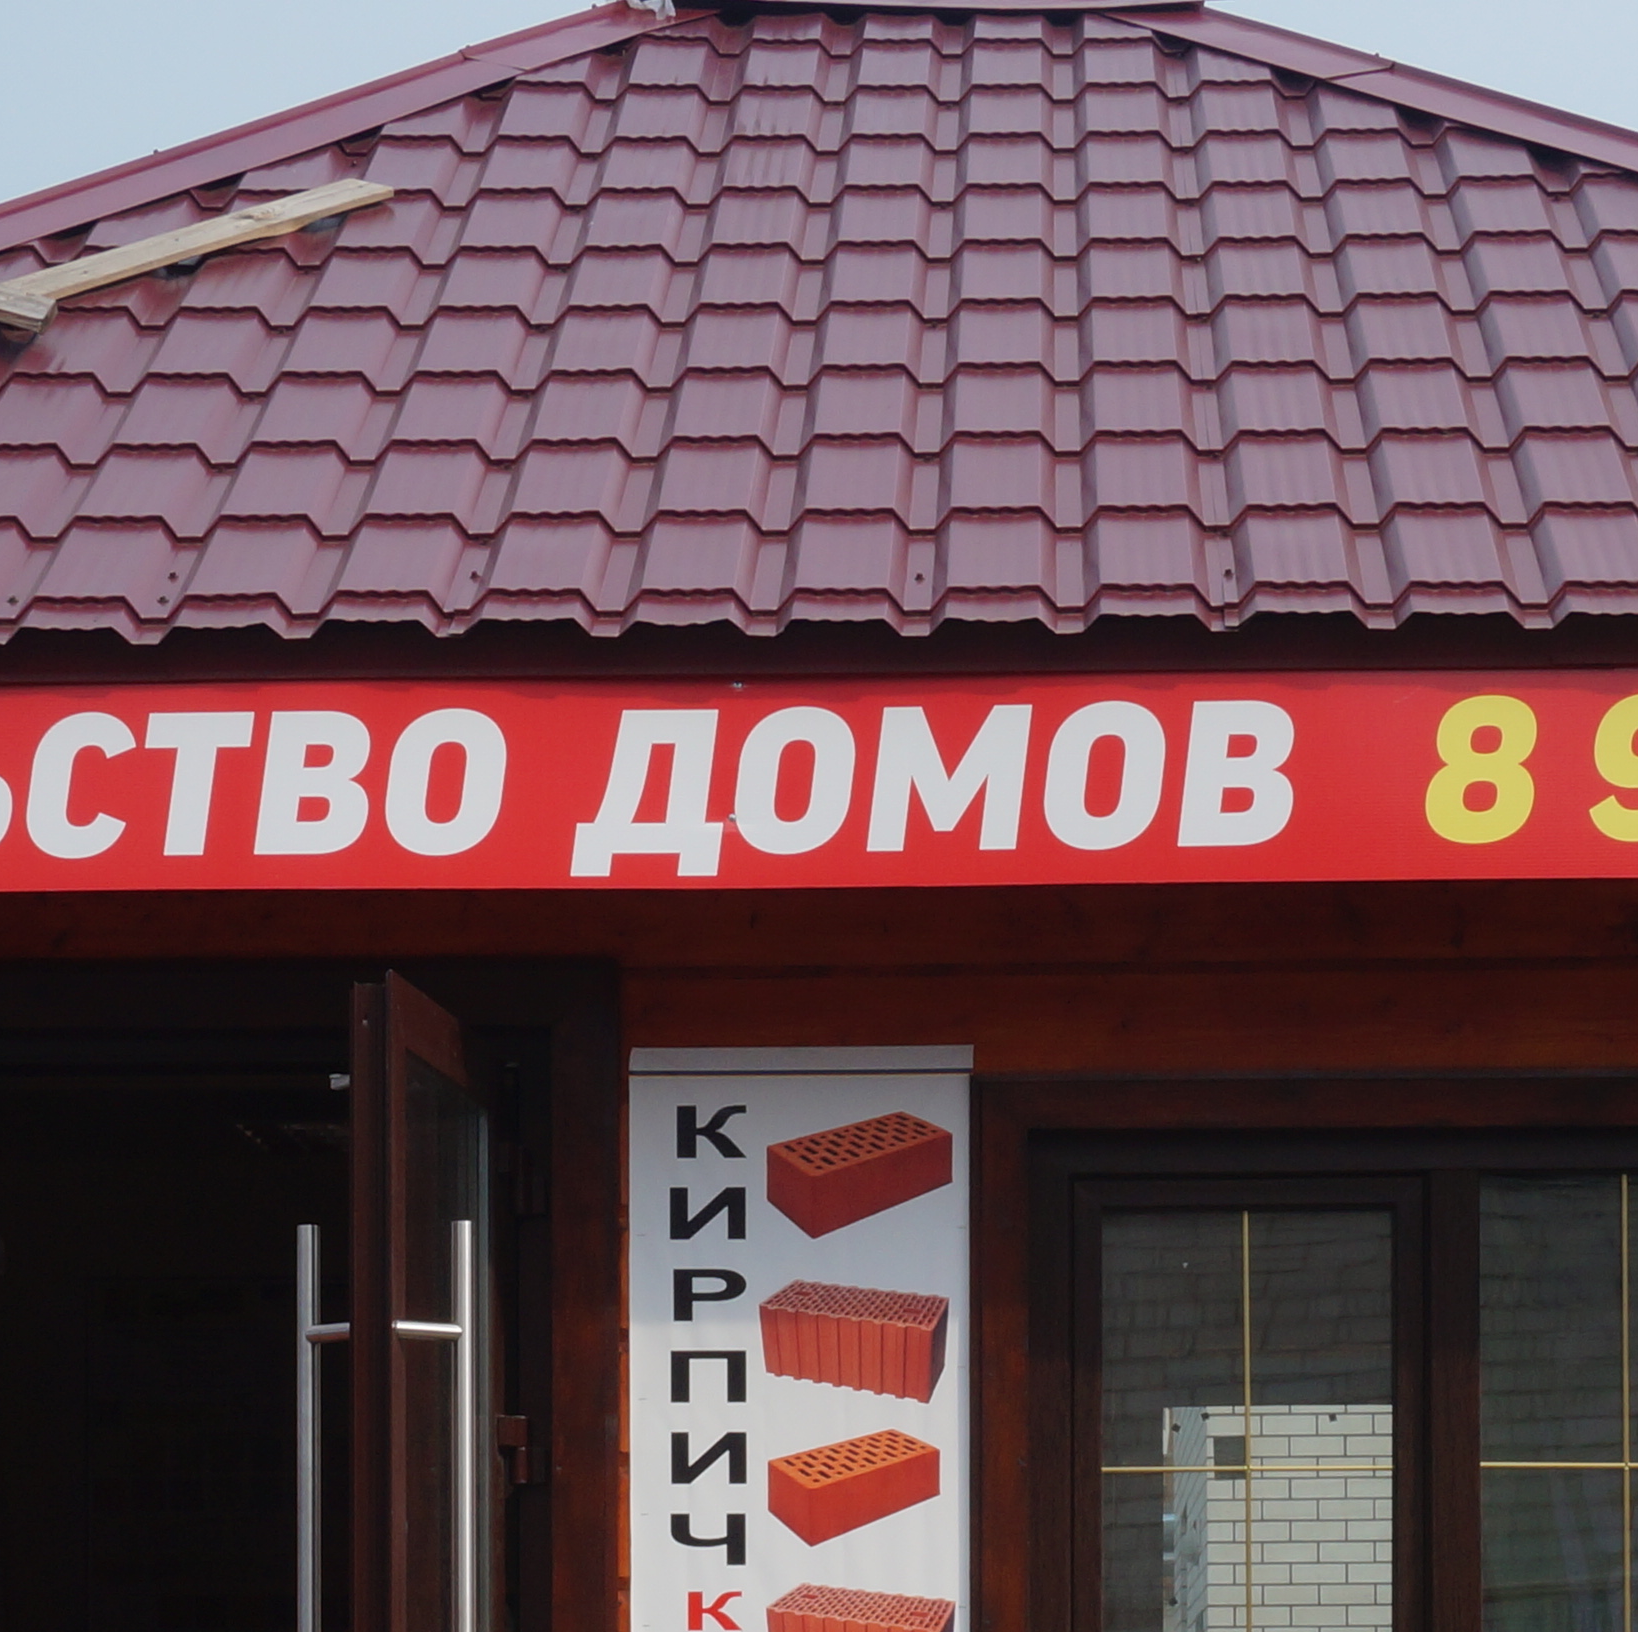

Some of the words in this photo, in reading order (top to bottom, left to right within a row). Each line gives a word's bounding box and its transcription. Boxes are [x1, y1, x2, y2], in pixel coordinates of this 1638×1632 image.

[570, 700, 1294, 877] ДОМОВ
[1425, 695, 1537, 844] 8
[669, 1104, 749, 1566] КИРПИЧ
